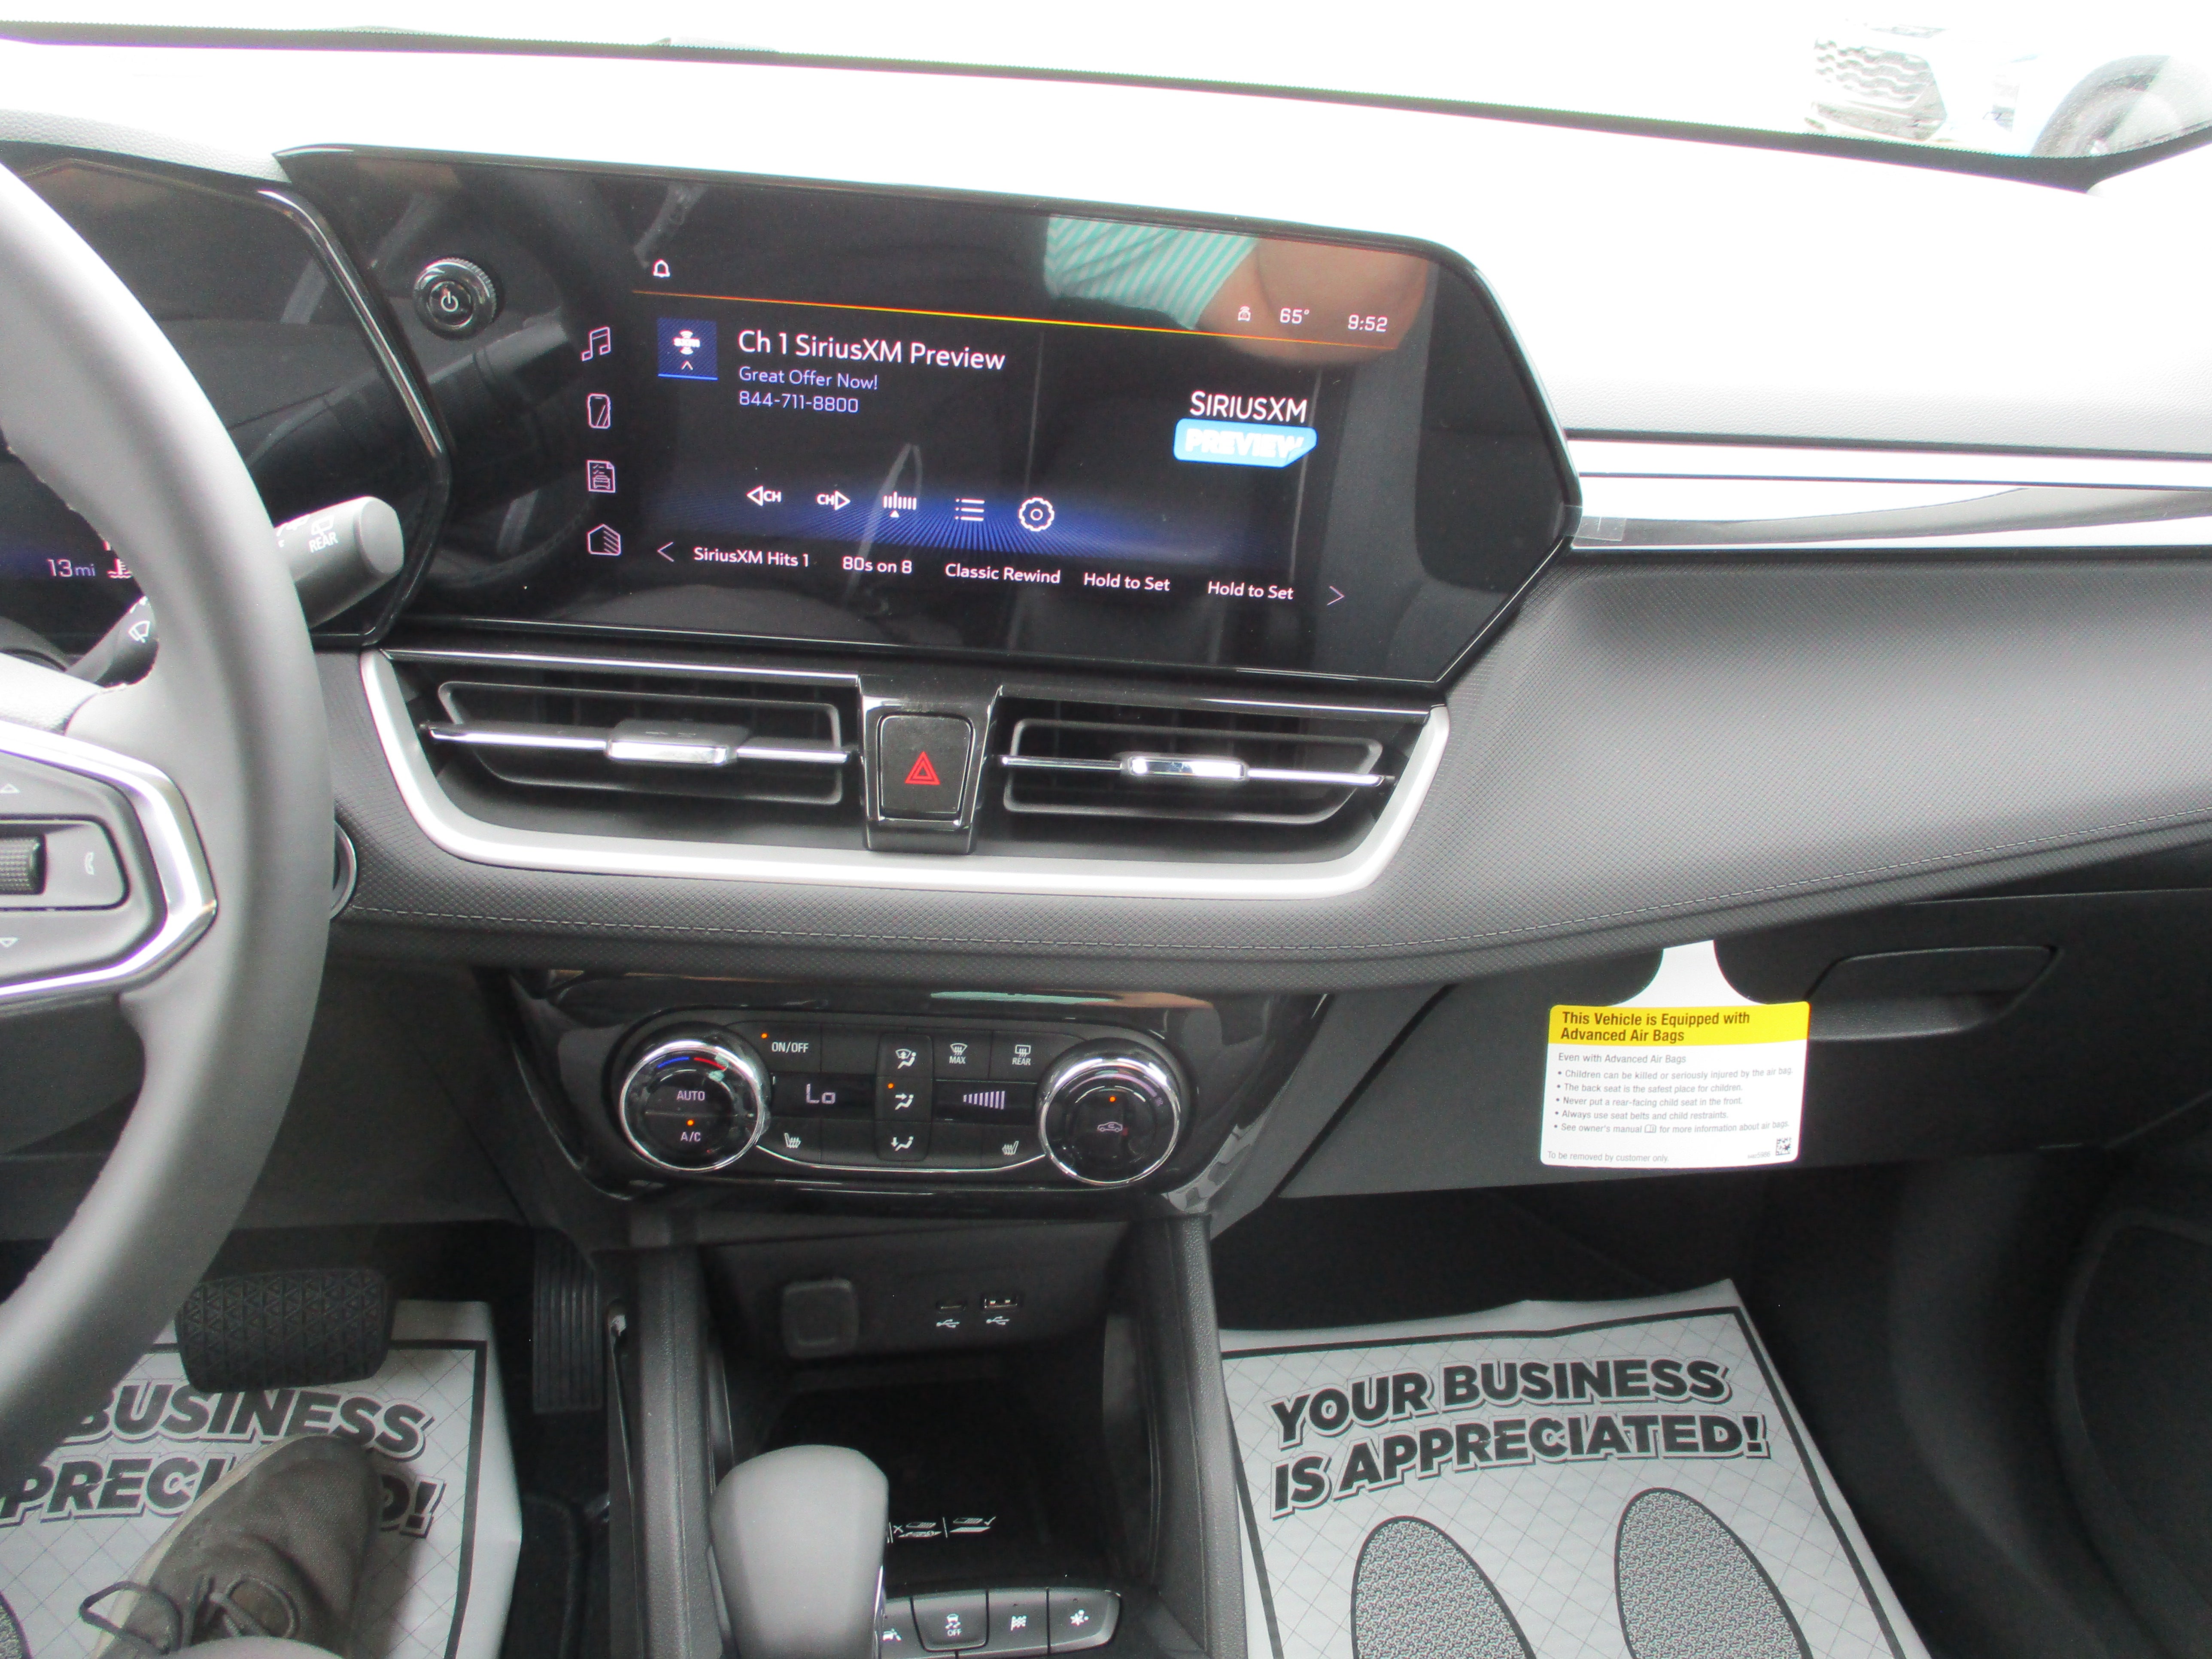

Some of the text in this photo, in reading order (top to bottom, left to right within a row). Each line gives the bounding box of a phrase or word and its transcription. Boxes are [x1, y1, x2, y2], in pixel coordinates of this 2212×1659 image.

[1347, 314, 1388, 333] 9:52
[738, 329, 1006, 371] Ch 1 SiriusXM Preview
[738, 366, 879, 391] Great Offer Now!
[738, 391, 859, 413] 844-711-8800
[1189, 390, 1308, 423] SIRIUSXM
[1184, 427, 1305, 459] PREVIEW
[763, 489, 781, 503] CH
[816, 493, 835, 506] CH
[308, 532, 338, 553] REAR
[693, 546, 810, 568] SiriusXM Hits 1
[842, 556, 913, 574] 80s on 8
[945, 563, 1061, 584] Classic Rewind
[1083, 572, 1171, 591] Hold to Set
[1207, 580, 1294, 600] Hold to Set
[1562, 1012, 1750, 1028] This Vehicle is Equipped with
[1560, 1028, 1685, 1044] Advanced Air Bags
[771, 1041, 809, 1054] ON/OFF
[948, 1054, 966, 1065] MAX
[1012, 1056, 1031, 1066] REAR
[1559, 1053, 1686, 1064] Even with Advanced Air Bags
[1565, 1069, 1601, 1079] Children
[1622, 1070, 1632, 1079] be
[1635, 1070, 1657, 1079] killed
[1671, 1070, 1708, 1081] seriously
[1711, 1069, 1738, 1079] injured
[1741, 1069, 1750, 1079] by
[1752, 1068, 1765, 1077] the
[1767, 1067, 1777, 1076] air
[1779, 1066, 1793, 1076] bag.
[676, 1089, 706, 1102] AUTO
[1565, 1082, 1743, 1094] The back seat is the safest place for children.
[1563, 1097, 1587, 1106] Never
[1589, 1098, 1603, 1107] put
[1613, 1098, 1657, 1108] rear-facing
[1659, 1097, 1678, 1106] child
[1681, 1098, 1698, 1106] seat
[1700, 1097, 1707, 1106] in
[1709, 1097, 1721, 1105] the
[1723, 1096, 1743, 1105] front.
[1562, 1110, 1591, 1121] Always
[1610, 1112, 1628, 1120] seat
[1630, 1111, 1650, 1120] belts
[1653, 1111, 1667, 1120] and
[1669, 1111, 1688, 1120] child
[1690, 1111, 1729, 1119] restraints.
[1561, 1123, 1576, 1132] See
[1578, 1124, 1610, 1133] owner's
[1613, 1124, 1642, 1133] manual
[1659, 1124, 1670, 1133] for
[1694, 1123, 1736, 1132] information
[1739, 1122, 1759, 1131] about
[1761, 1121, 1770, 1130] air
[1772, 1121, 1790, 1130] bags.
[680, 1131, 702, 1142] A/C
[1547, 1151, 1669, 1163] To be removed by customer only.
[1272, 1359, 1726, 1441] YOUR BUSINESS
[1275, 1416, 1762, 1511] IS APPRECIATED!
